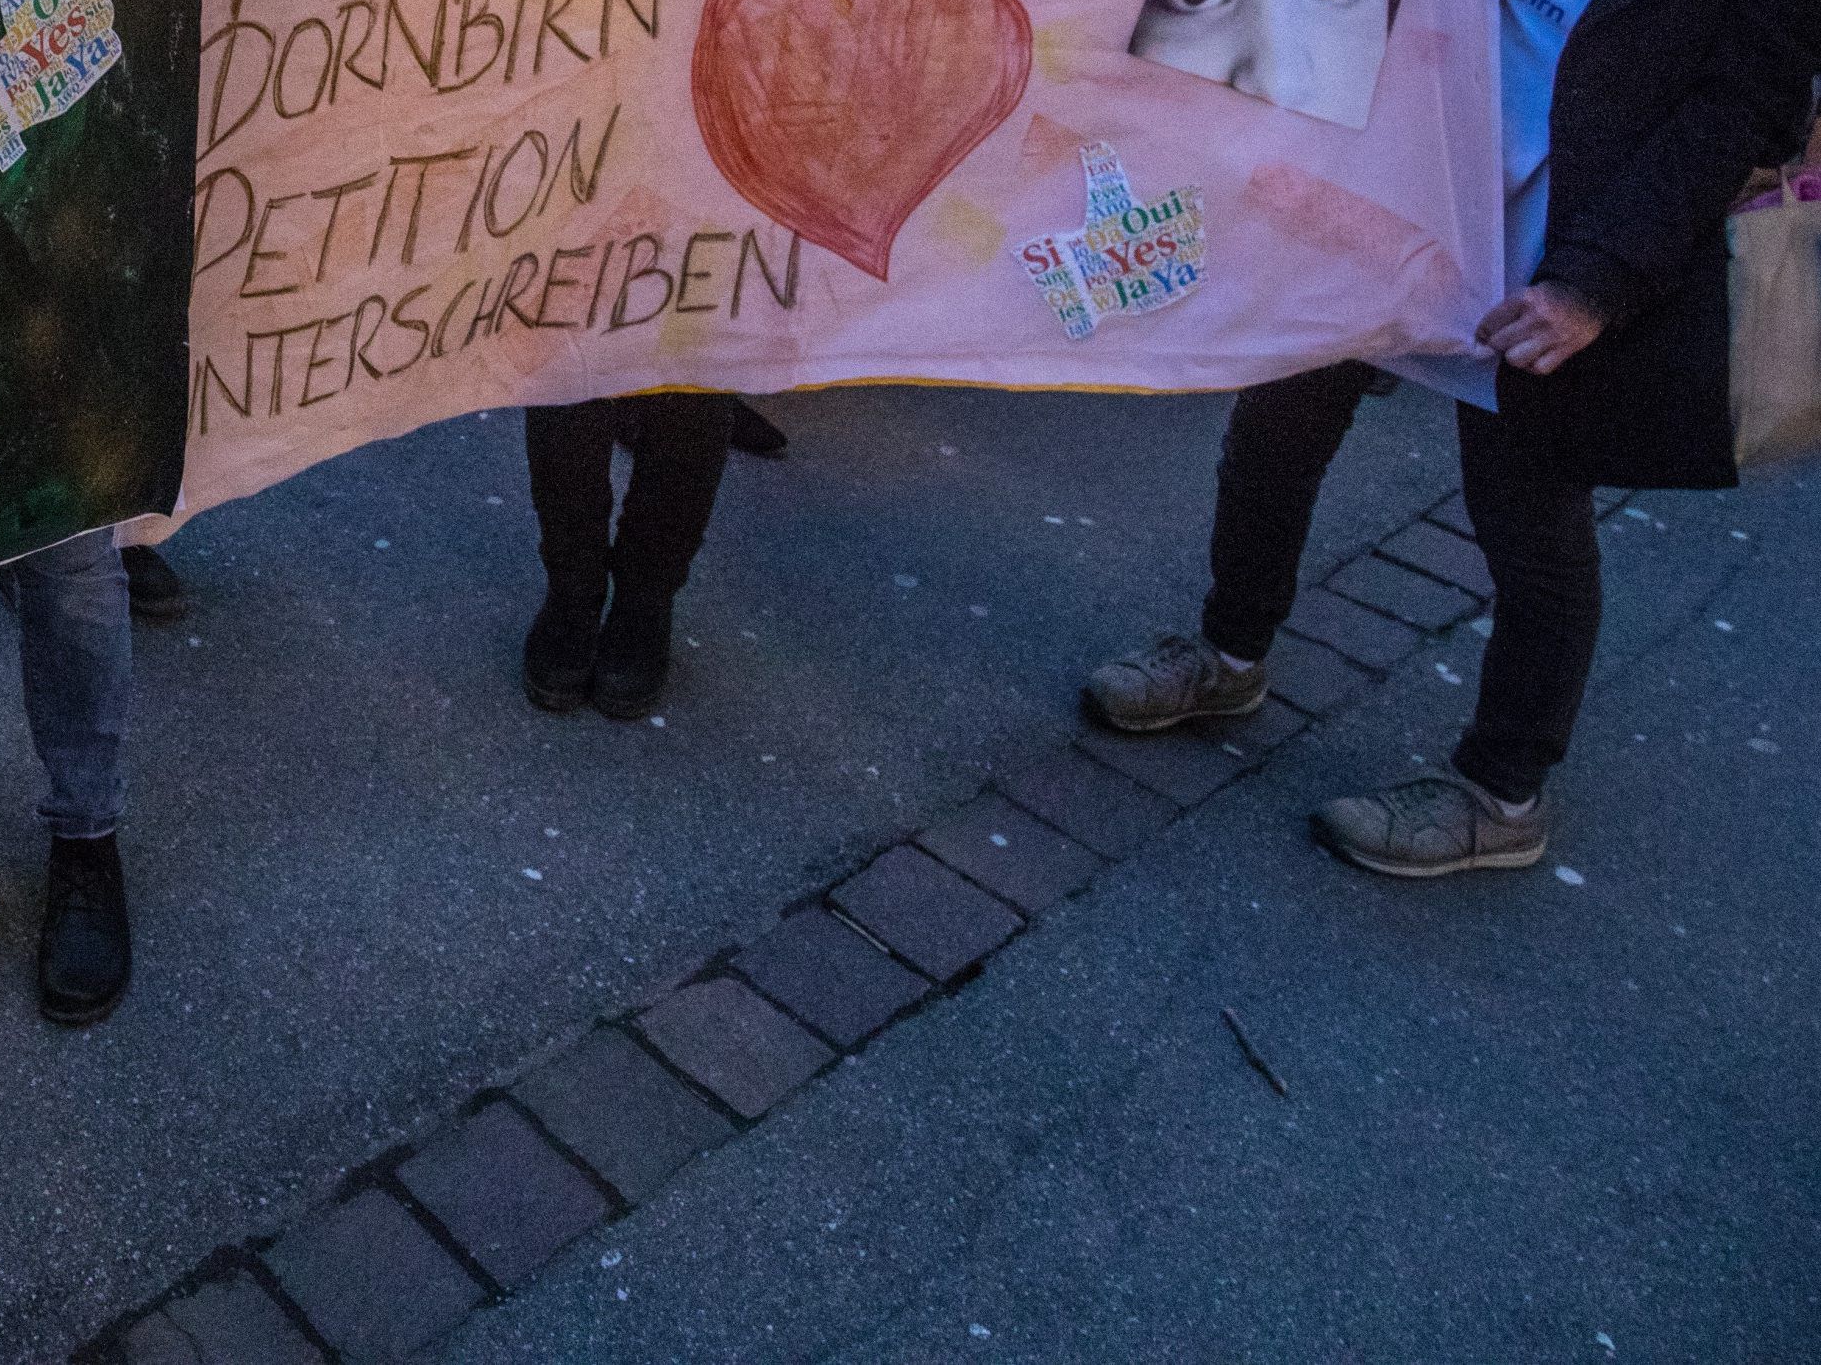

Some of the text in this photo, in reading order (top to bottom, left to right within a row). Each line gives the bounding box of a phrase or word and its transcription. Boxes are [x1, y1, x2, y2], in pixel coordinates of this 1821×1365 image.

[20, 5, 86, 73] Yes
[65, 36, 109, 81] Ya
[34, 70, 69, 113] Ja
[191, 104, 622, 300] PETITION
[1121, 190, 1184, 235] Oui
[1022, 238, 1064, 275] Si
[1104, 233, 1178, 276] Yes
[1113, 279, 1150, 310] Ja
[1150, 260, 1198, 294] Ya
